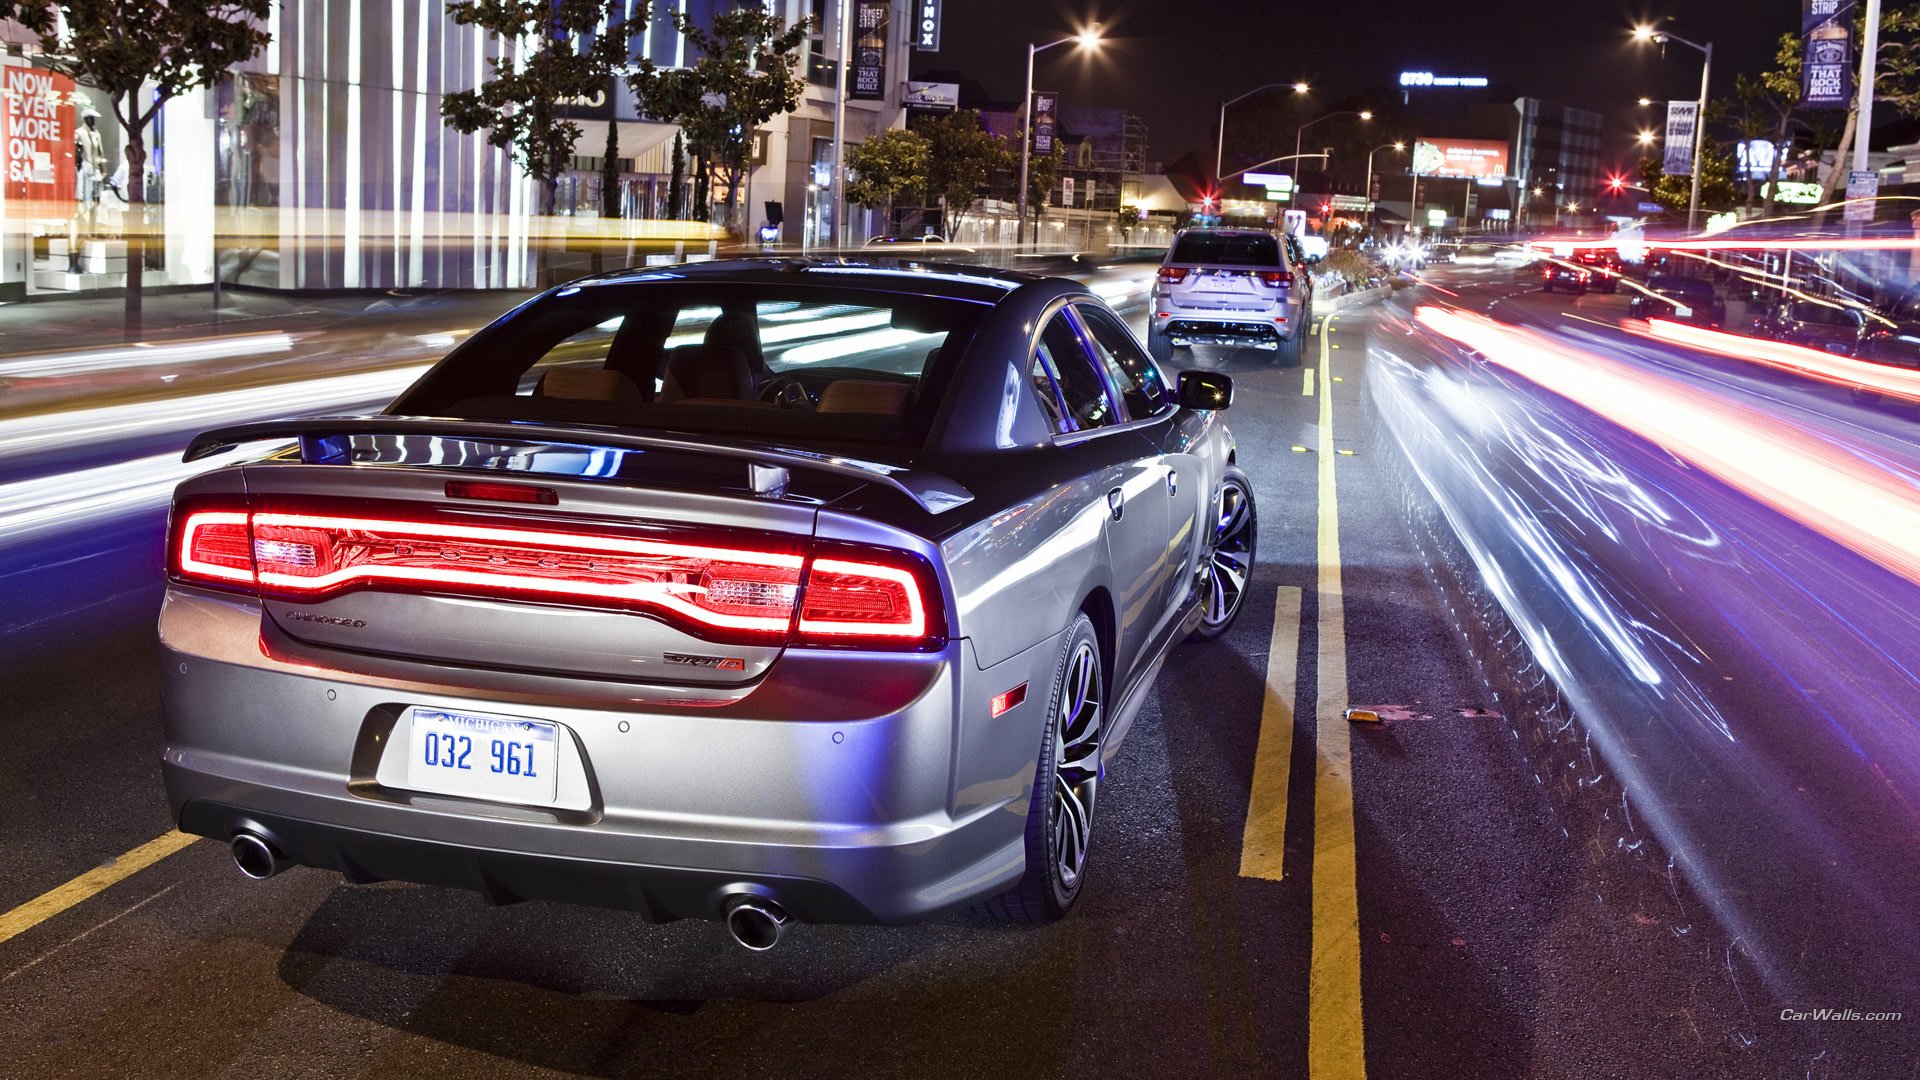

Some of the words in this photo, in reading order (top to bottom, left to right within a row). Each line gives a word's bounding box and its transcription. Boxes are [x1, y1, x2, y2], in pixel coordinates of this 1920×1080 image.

[860, 9, 884, 19] SUNSET
[1811, 1, 1838, 15] STRIP
[9, 70, 53, 95] NOW
[1810, 70, 1842, 78] THAT
[1810, 78, 1841, 87] ROCK
[9, 93, 57, 119] EVEN
[9, 115, 61, 141] MORE
[9, 137, 37, 160] ON
[9, 160, 55, 184] SA
[448, 715, 521, 734] MICHIGAN
[425, 731, 472, 770] 032
[490, 739, 537, 777] 961
